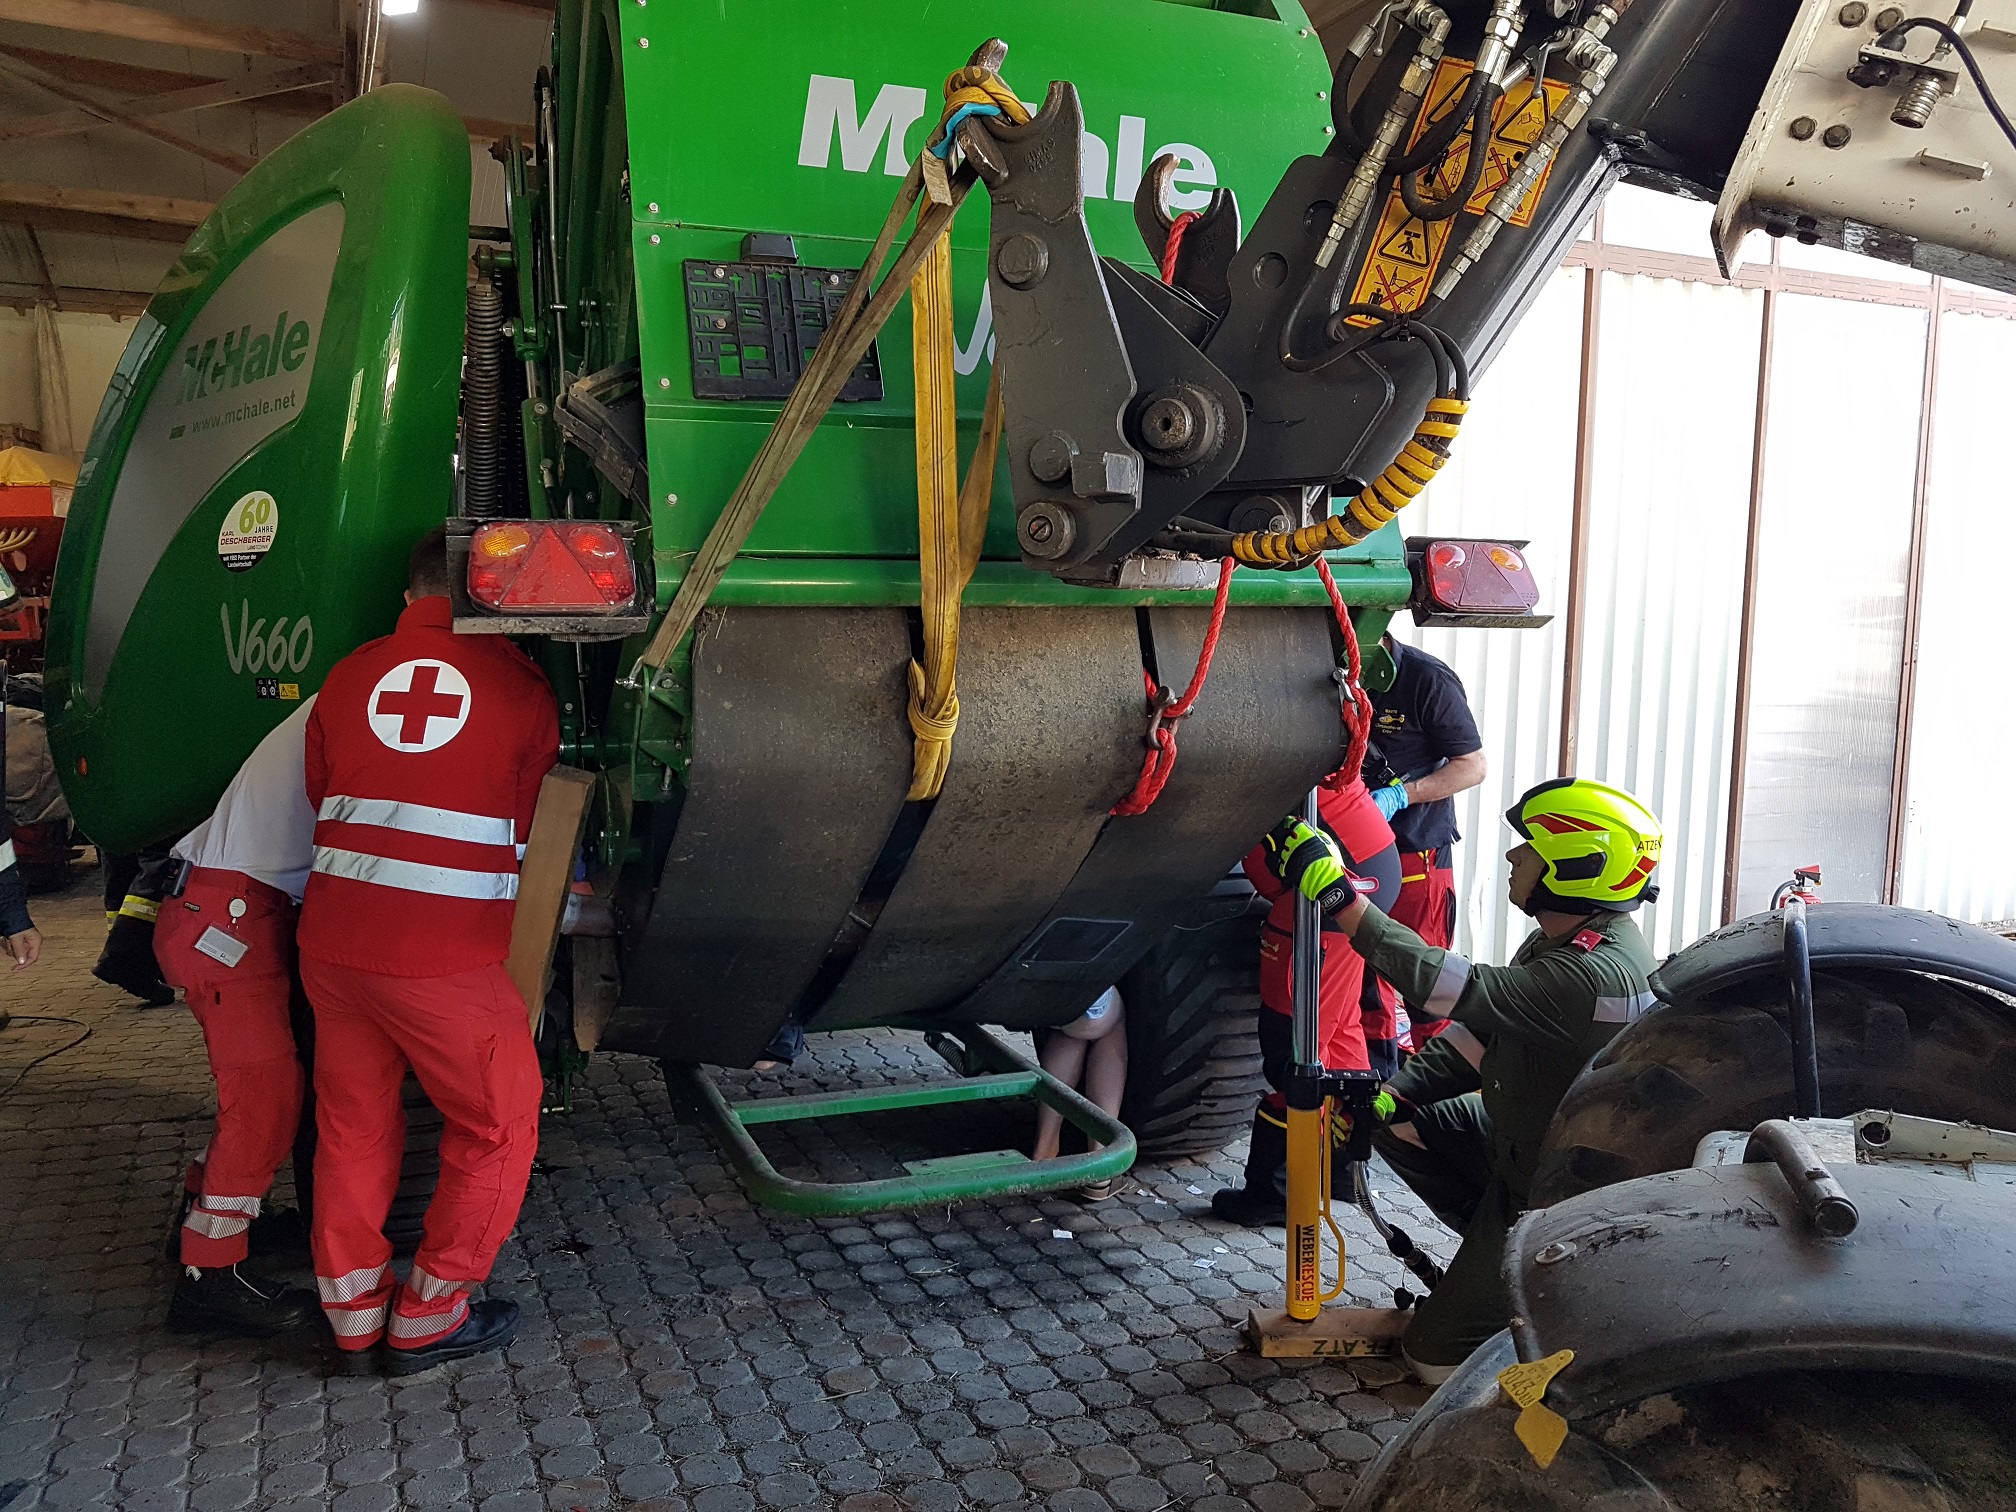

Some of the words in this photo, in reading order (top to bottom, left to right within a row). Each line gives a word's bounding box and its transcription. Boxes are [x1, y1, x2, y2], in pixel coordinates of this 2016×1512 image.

[175, 310, 310, 405] McHale
[192, 390, 296, 423] www.mchale.net
[239, 497, 271, 534] 60
[221, 530, 235, 538] KARL
[254, 525, 274, 534] JAHRE
[220, 535, 271, 546] DESCHBERGER
[238, 553, 251, 561] Partner
[227, 560, 253, 568] Landwirtschaft
[220, 598, 314, 675] V660
